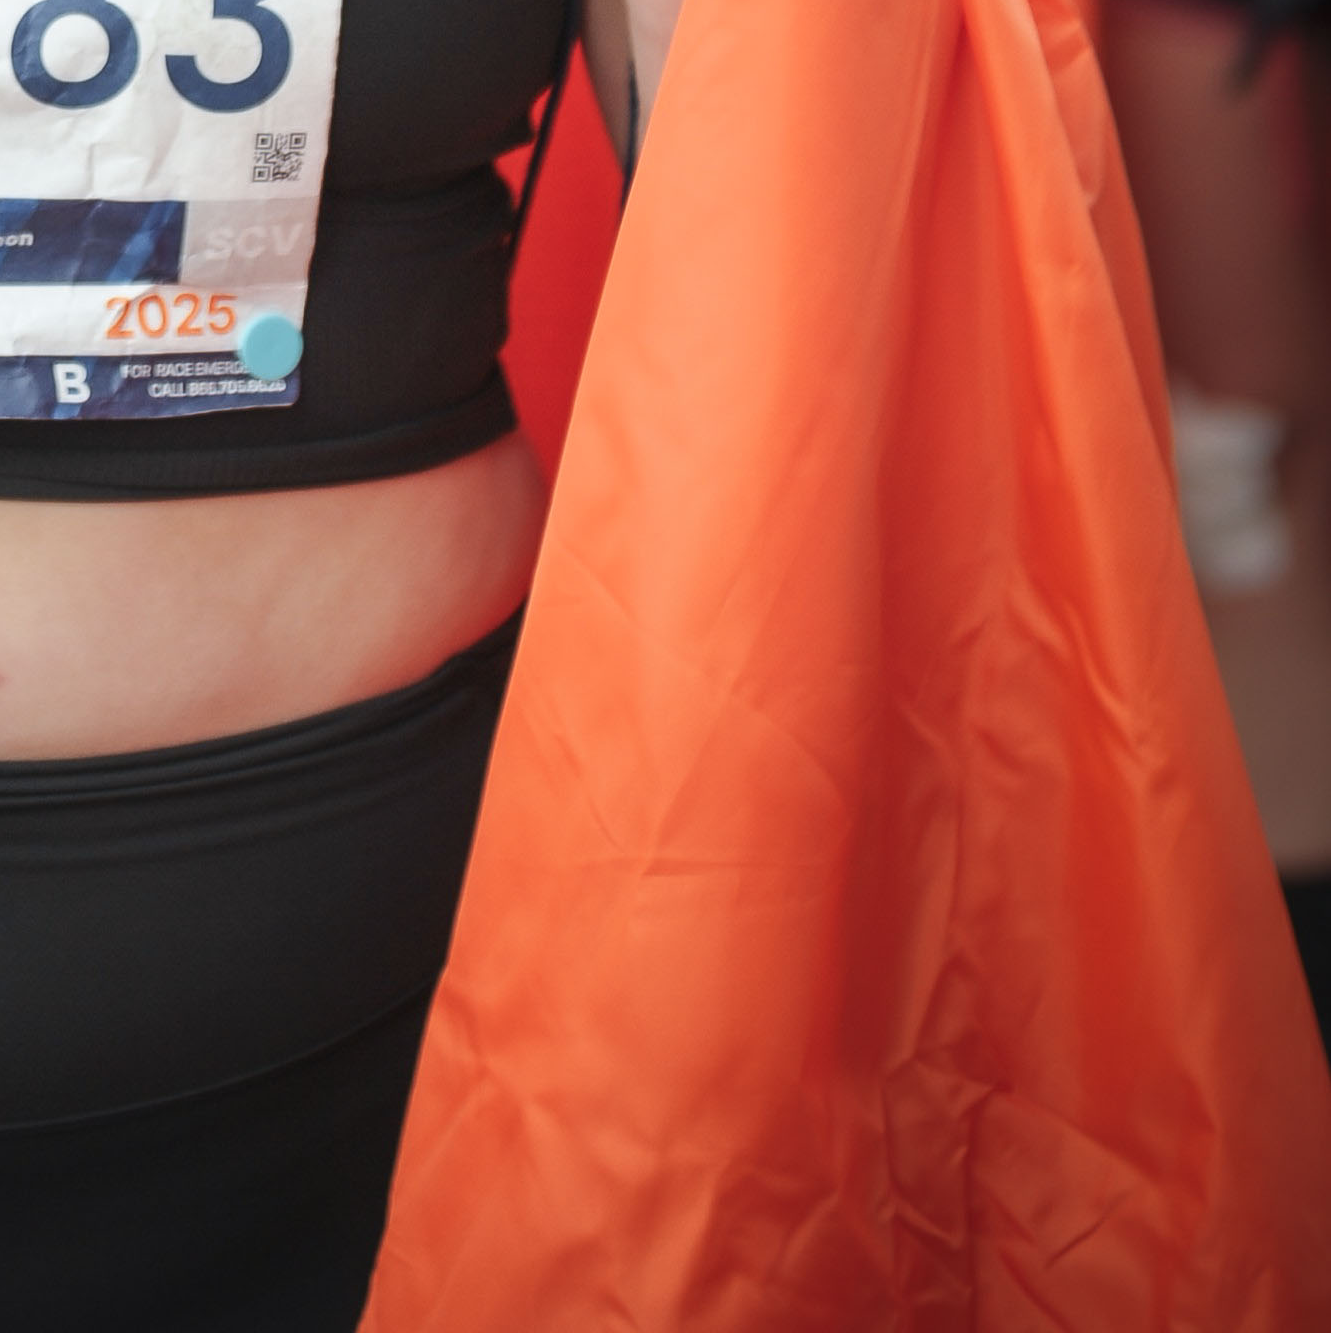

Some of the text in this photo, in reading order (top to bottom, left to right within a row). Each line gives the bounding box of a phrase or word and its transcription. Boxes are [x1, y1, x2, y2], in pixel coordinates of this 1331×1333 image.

[104, 292, 239, 340] 2025
[194, 360, 251, 376] EMERG
[53, 362, 92, 404] B
[148, 381, 187, 398] CALL
